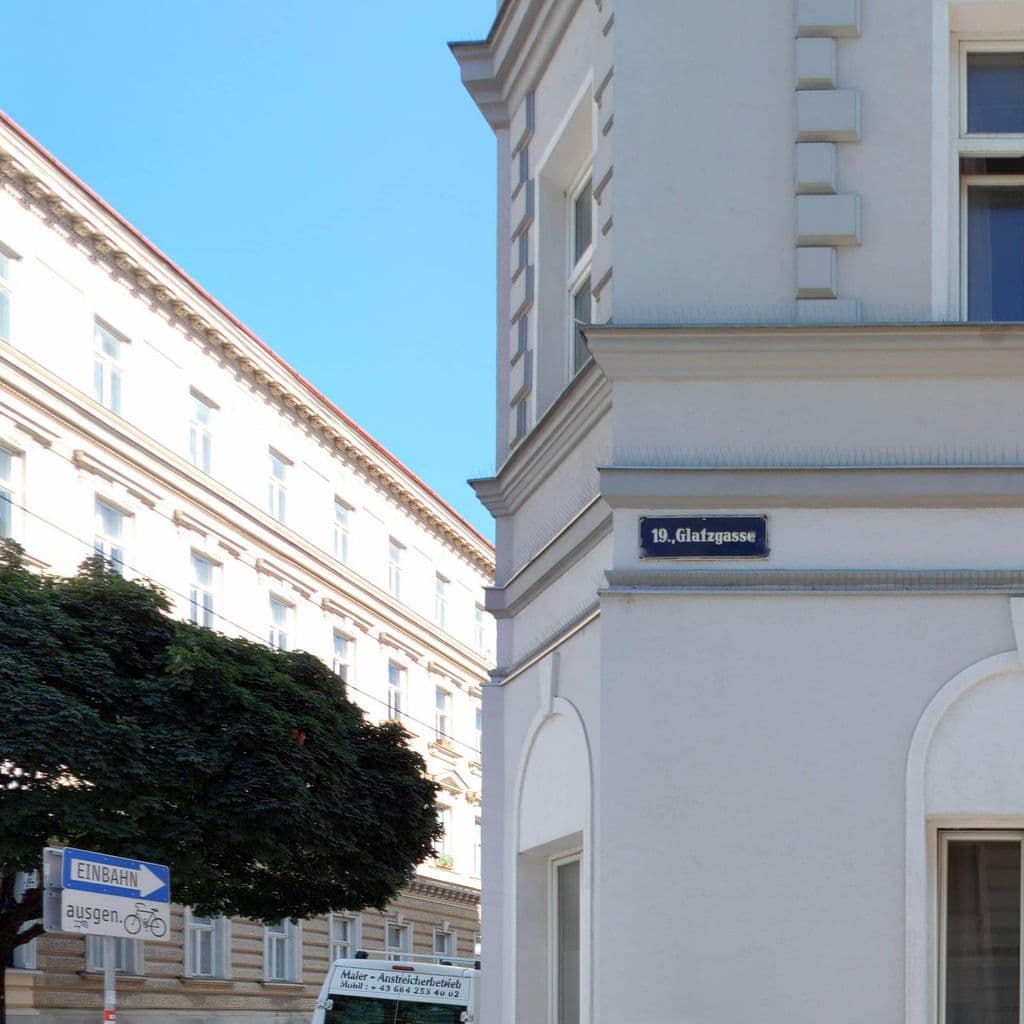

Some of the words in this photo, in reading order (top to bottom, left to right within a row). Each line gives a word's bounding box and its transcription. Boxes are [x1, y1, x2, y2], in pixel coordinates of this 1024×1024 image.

[77, 862, 138, 887] EINBAHN
[66, 904, 123, 925] ausgen.
[377, 972, 461, 989] Anstreicherbetrieb
